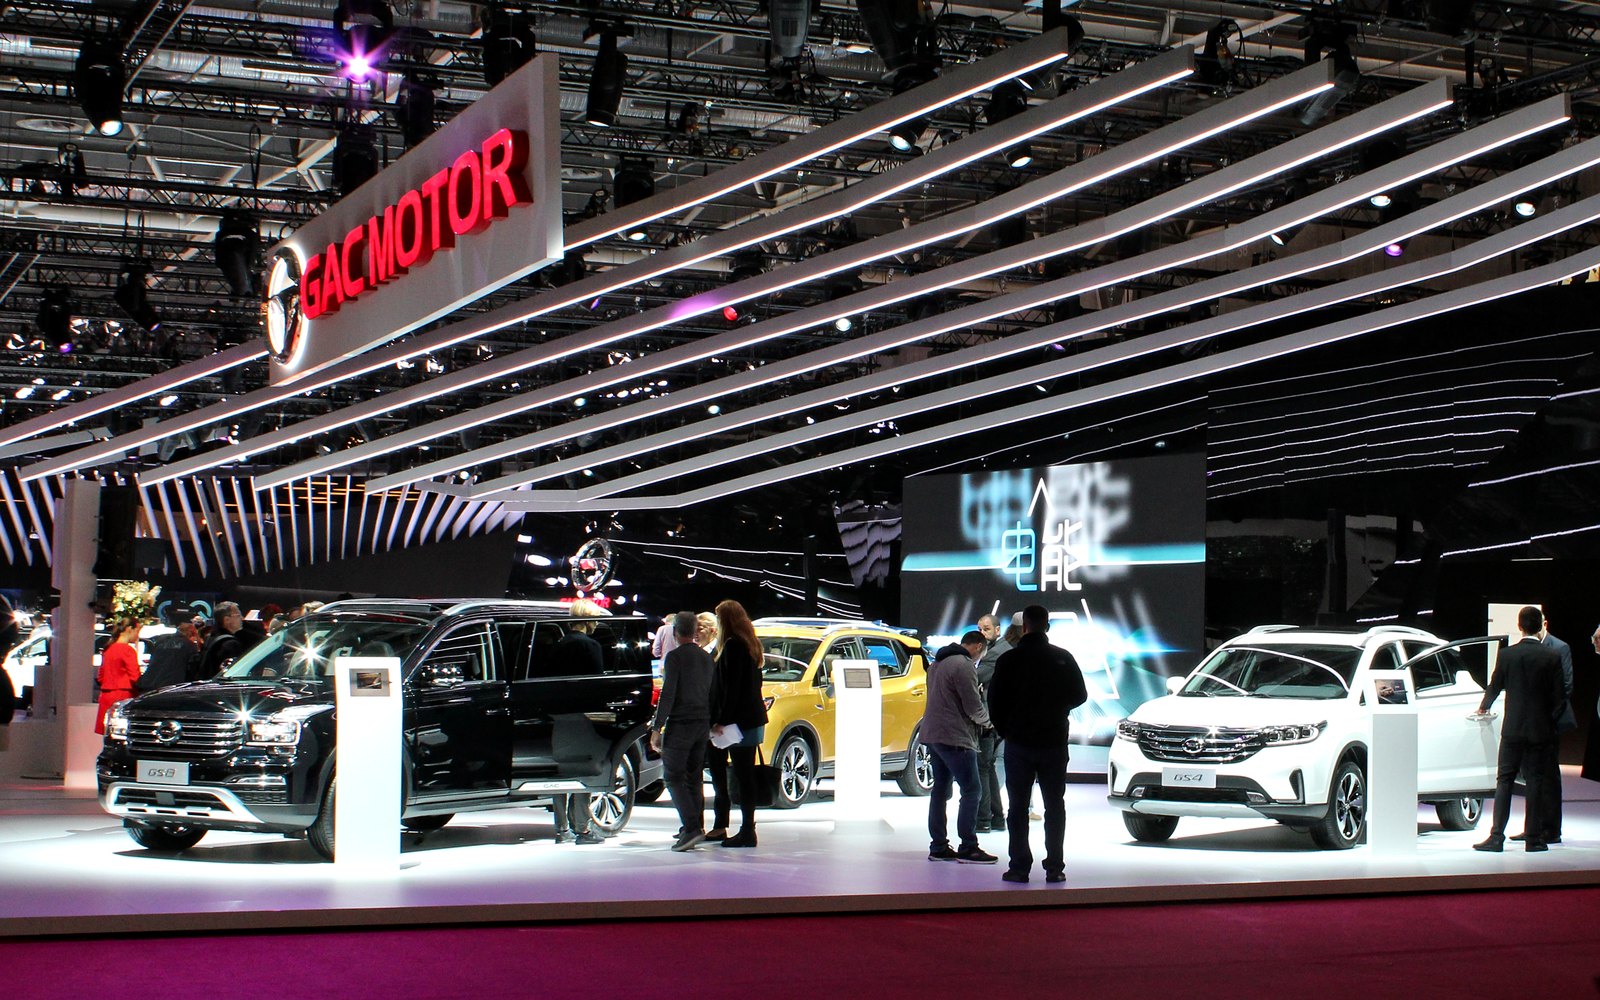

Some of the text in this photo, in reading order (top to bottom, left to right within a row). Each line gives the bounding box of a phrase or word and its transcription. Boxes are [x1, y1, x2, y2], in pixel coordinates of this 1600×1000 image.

[302, 128, 532, 320] GAC MOTOR
[1173, 773, 1203, 782] GS4
